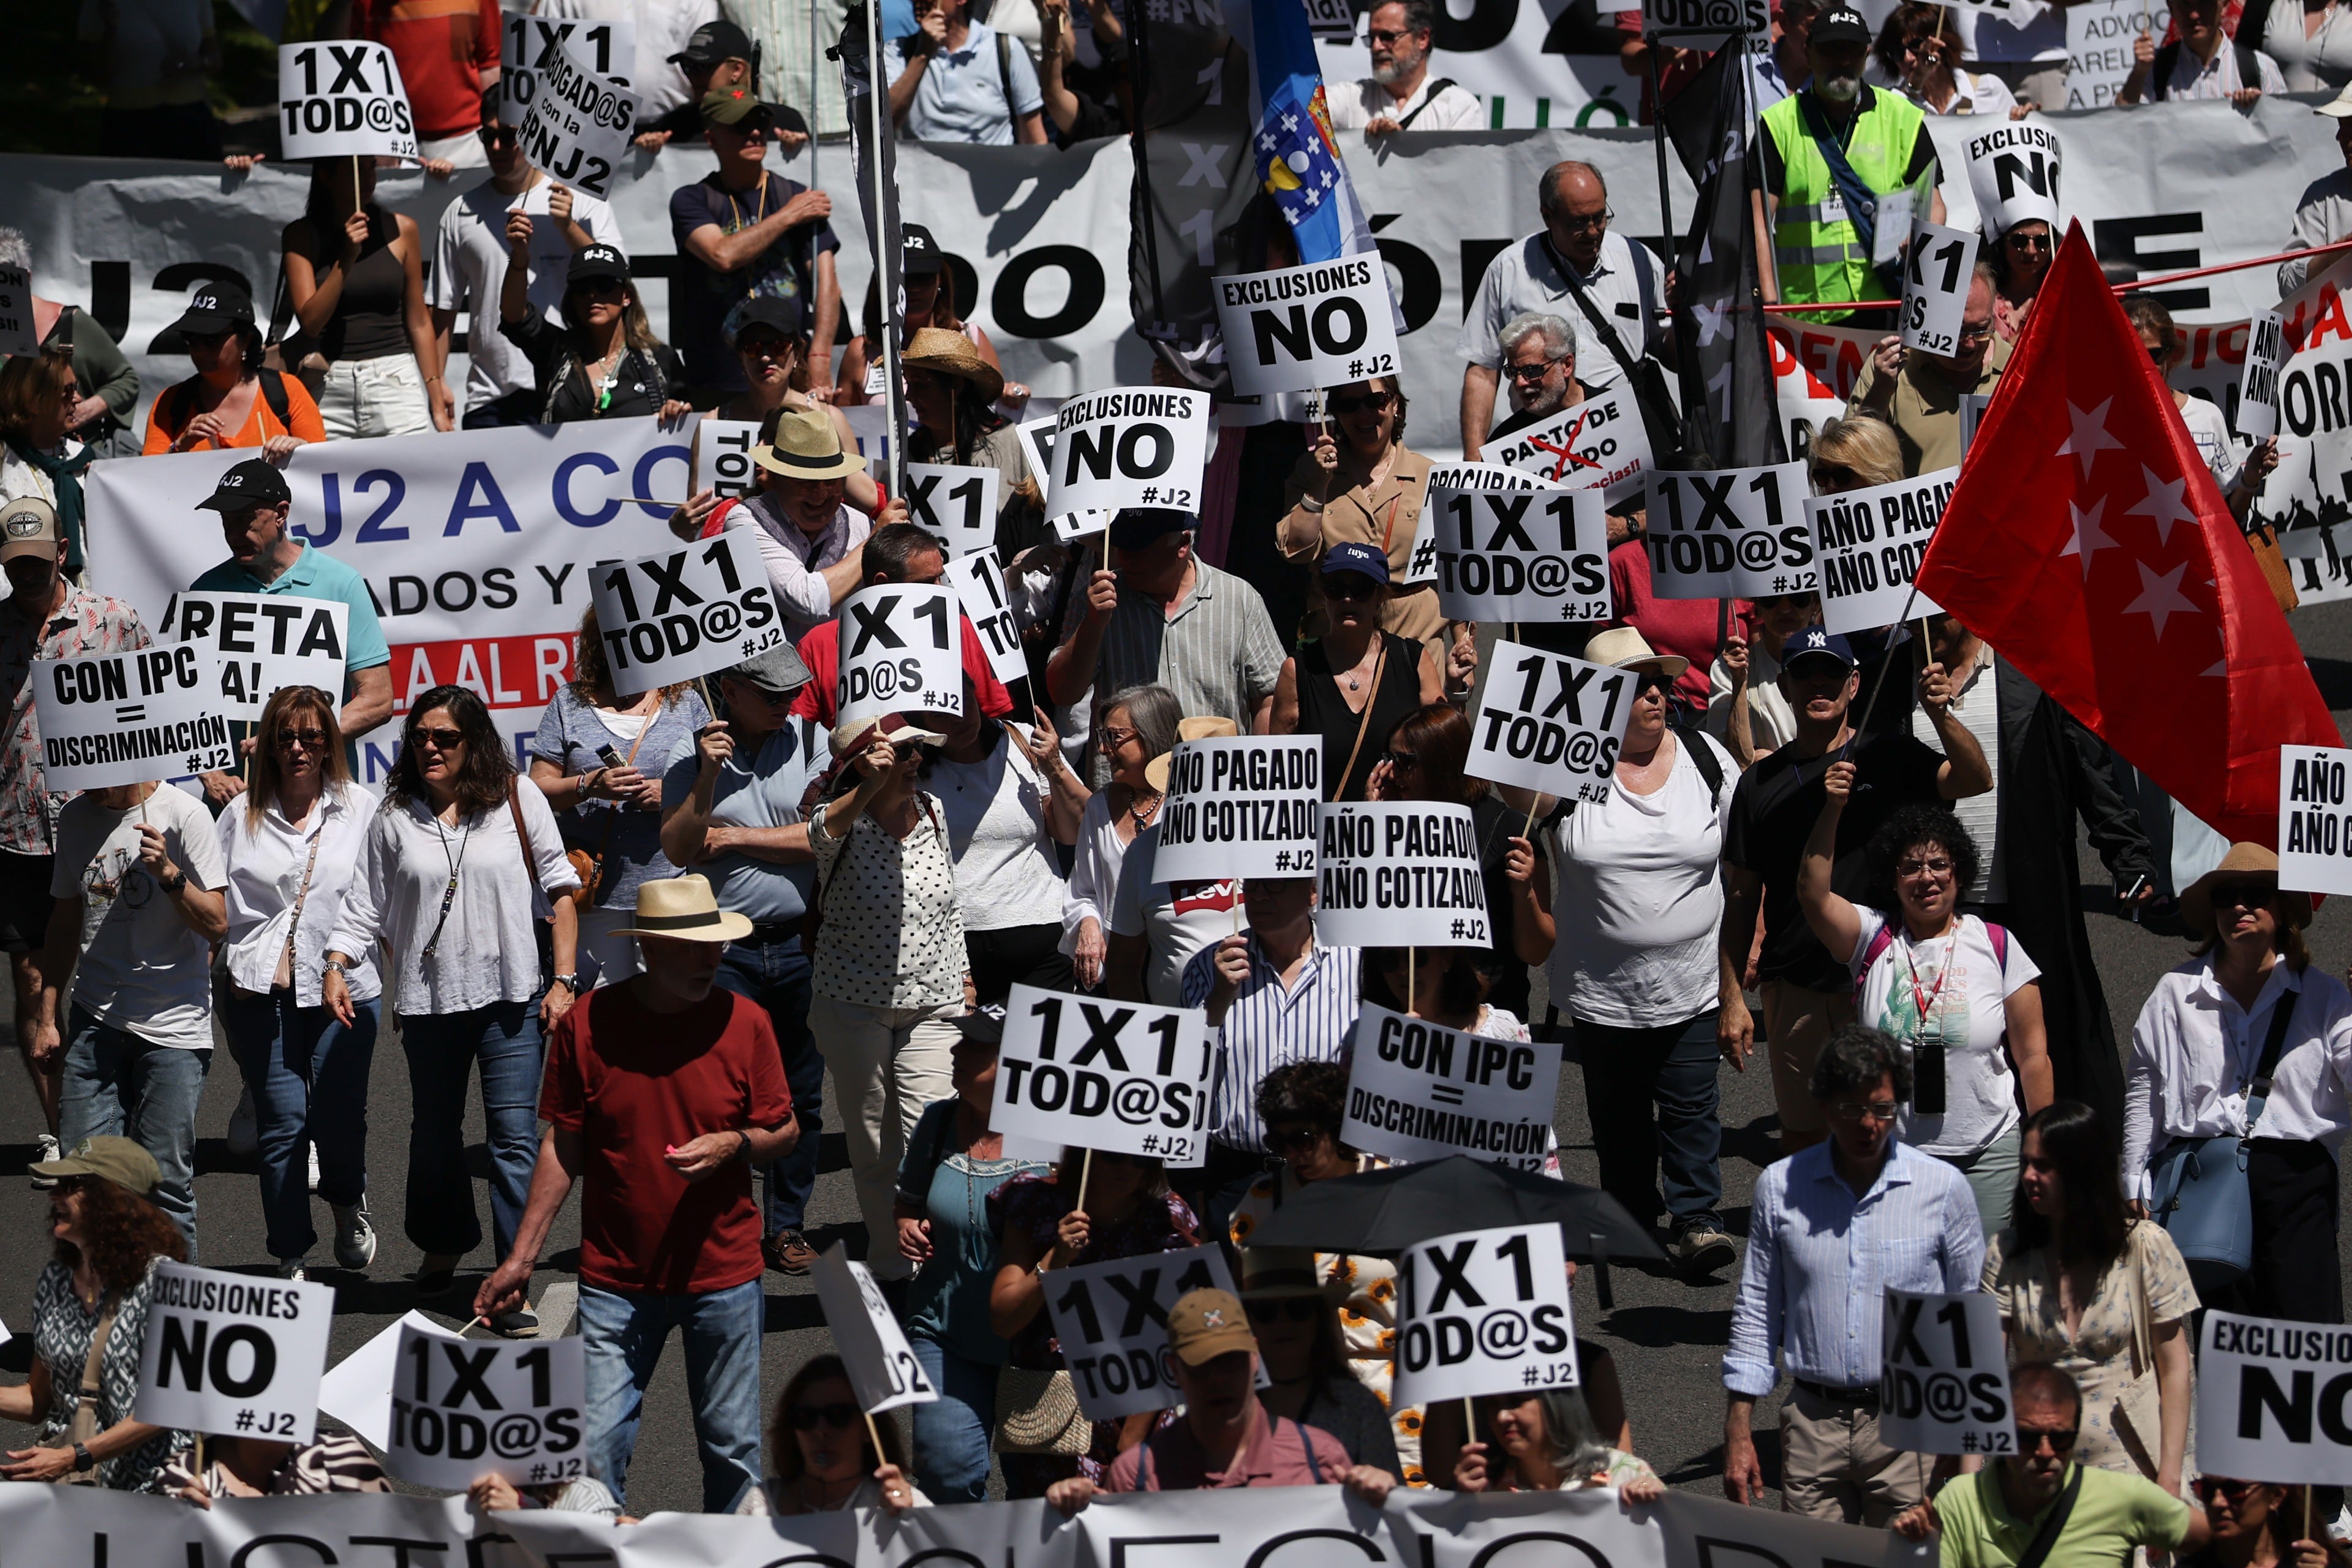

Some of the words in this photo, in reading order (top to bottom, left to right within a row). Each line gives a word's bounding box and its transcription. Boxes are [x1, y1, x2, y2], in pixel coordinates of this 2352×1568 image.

[1829, 12, 1860, 26] #J2
[295, 46, 394, 96] 1X1
[282, 98, 411, 135] TOD@S
[541, 97, 562, 121] con
[563, 116, 581, 136] la
[391, 141, 417, 155] #J2
[518, 105, 611, 195] #PNJ2
[584, 249, 616, 263] #J2
[903, 236, 925, 250] J2
[1223, 260, 1371, 307] EXCLUSIONES
[1251, 296, 1368, 366] NO
[1918, 331, 1952, 352] #J2
[1348, 353, 1393, 379] #J2
[1059, 393, 1192, 433] EXCLUSIONES
[1585, 401, 1620, 429] DE
[1065, 423, 1175, 488] NO
[442, 461, 522, 538] A
[1142, 486, 1191, 507] #J2
[1657, 470, 1784, 532] 1X1
[1448, 494, 1575, 552] 1X1
[1815, 497, 1875, 551] AÑO
[1347, 545, 1370, 560] tuyo
[1436, 551, 1606, 596] TOD@S
[1649, 526, 1814, 575] TOD@S
[1823, 546, 1879, 600] AÑO
[535, 562, 575, 605] Y
[605, 538, 742, 624] 1X1
[1773, 571, 1818, 594] #J2
[604, 586, 774, 670] TOD@S
[849, 594, 950, 660] X1
[1561, 601, 1608, 620] #J2
[741, 627, 783, 658] #J2
[52, 658, 127, 706] CON
[137, 646, 198, 696] IPC
[839, 657, 924, 711] OD@S
[923, 689, 960, 711] #J2
[1517, 654, 1626, 733] 1X1
[46, 711, 227, 768] DISCRIMINACIÓN
[186, 748, 232, 774] #J2
[1482, 707, 1619, 778] TOD@S
[1168, 745, 1204, 797] AÑO
[1214, 747, 1317, 792] PAGADO
[1578, 782, 1607, 804] #J2
[2290, 752, 2345, 806] AÑO
[1159, 797, 1196, 846] AÑO
[1202, 799, 1317, 842] COTIZADO
[1323, 807, 1374, 859] AÑO
[1387, 814, 1477, 862] PAGADO
[2287, 804, 2338, 856] AÑO
[1275, 850, 1314, 872] #J2
[1321, 860, 1368, 910] AÑO
[1376, 865, 1484, 911] COTIZADO
[1450, 919, 1485, 940] #J2
[1031, 997, 1180, 1077] 1X1
[1378, 1016, 1455, 1079] CON
[1466, 1038, 1535, 1090] IPC
[1001, 1057, 1192, 1128] TOD@S
[1142, 1134, 1187, 1156] #J2
[1349, 1087, 1548, 1155] DISCRIMINACIÓN
[153, 1275, 300, 1320] EXCLUSIONES
[156, 1314, 277, 1400] NO
[1395, 1304, 1569, 1381] OD@S
[2212, 1318, 2352, 1363] EXCLUSIO
[408, 1335, 551, 1411] 1X1
[1521, 1362, 1572, 1386] #J2
[235, 1408, 295, 1436] #J2
[393, 1403, 581, 1463] TOD@S
[1962, 1432, 2013, 1452] #J2
[529, 1458, 582, 1482] #J2
